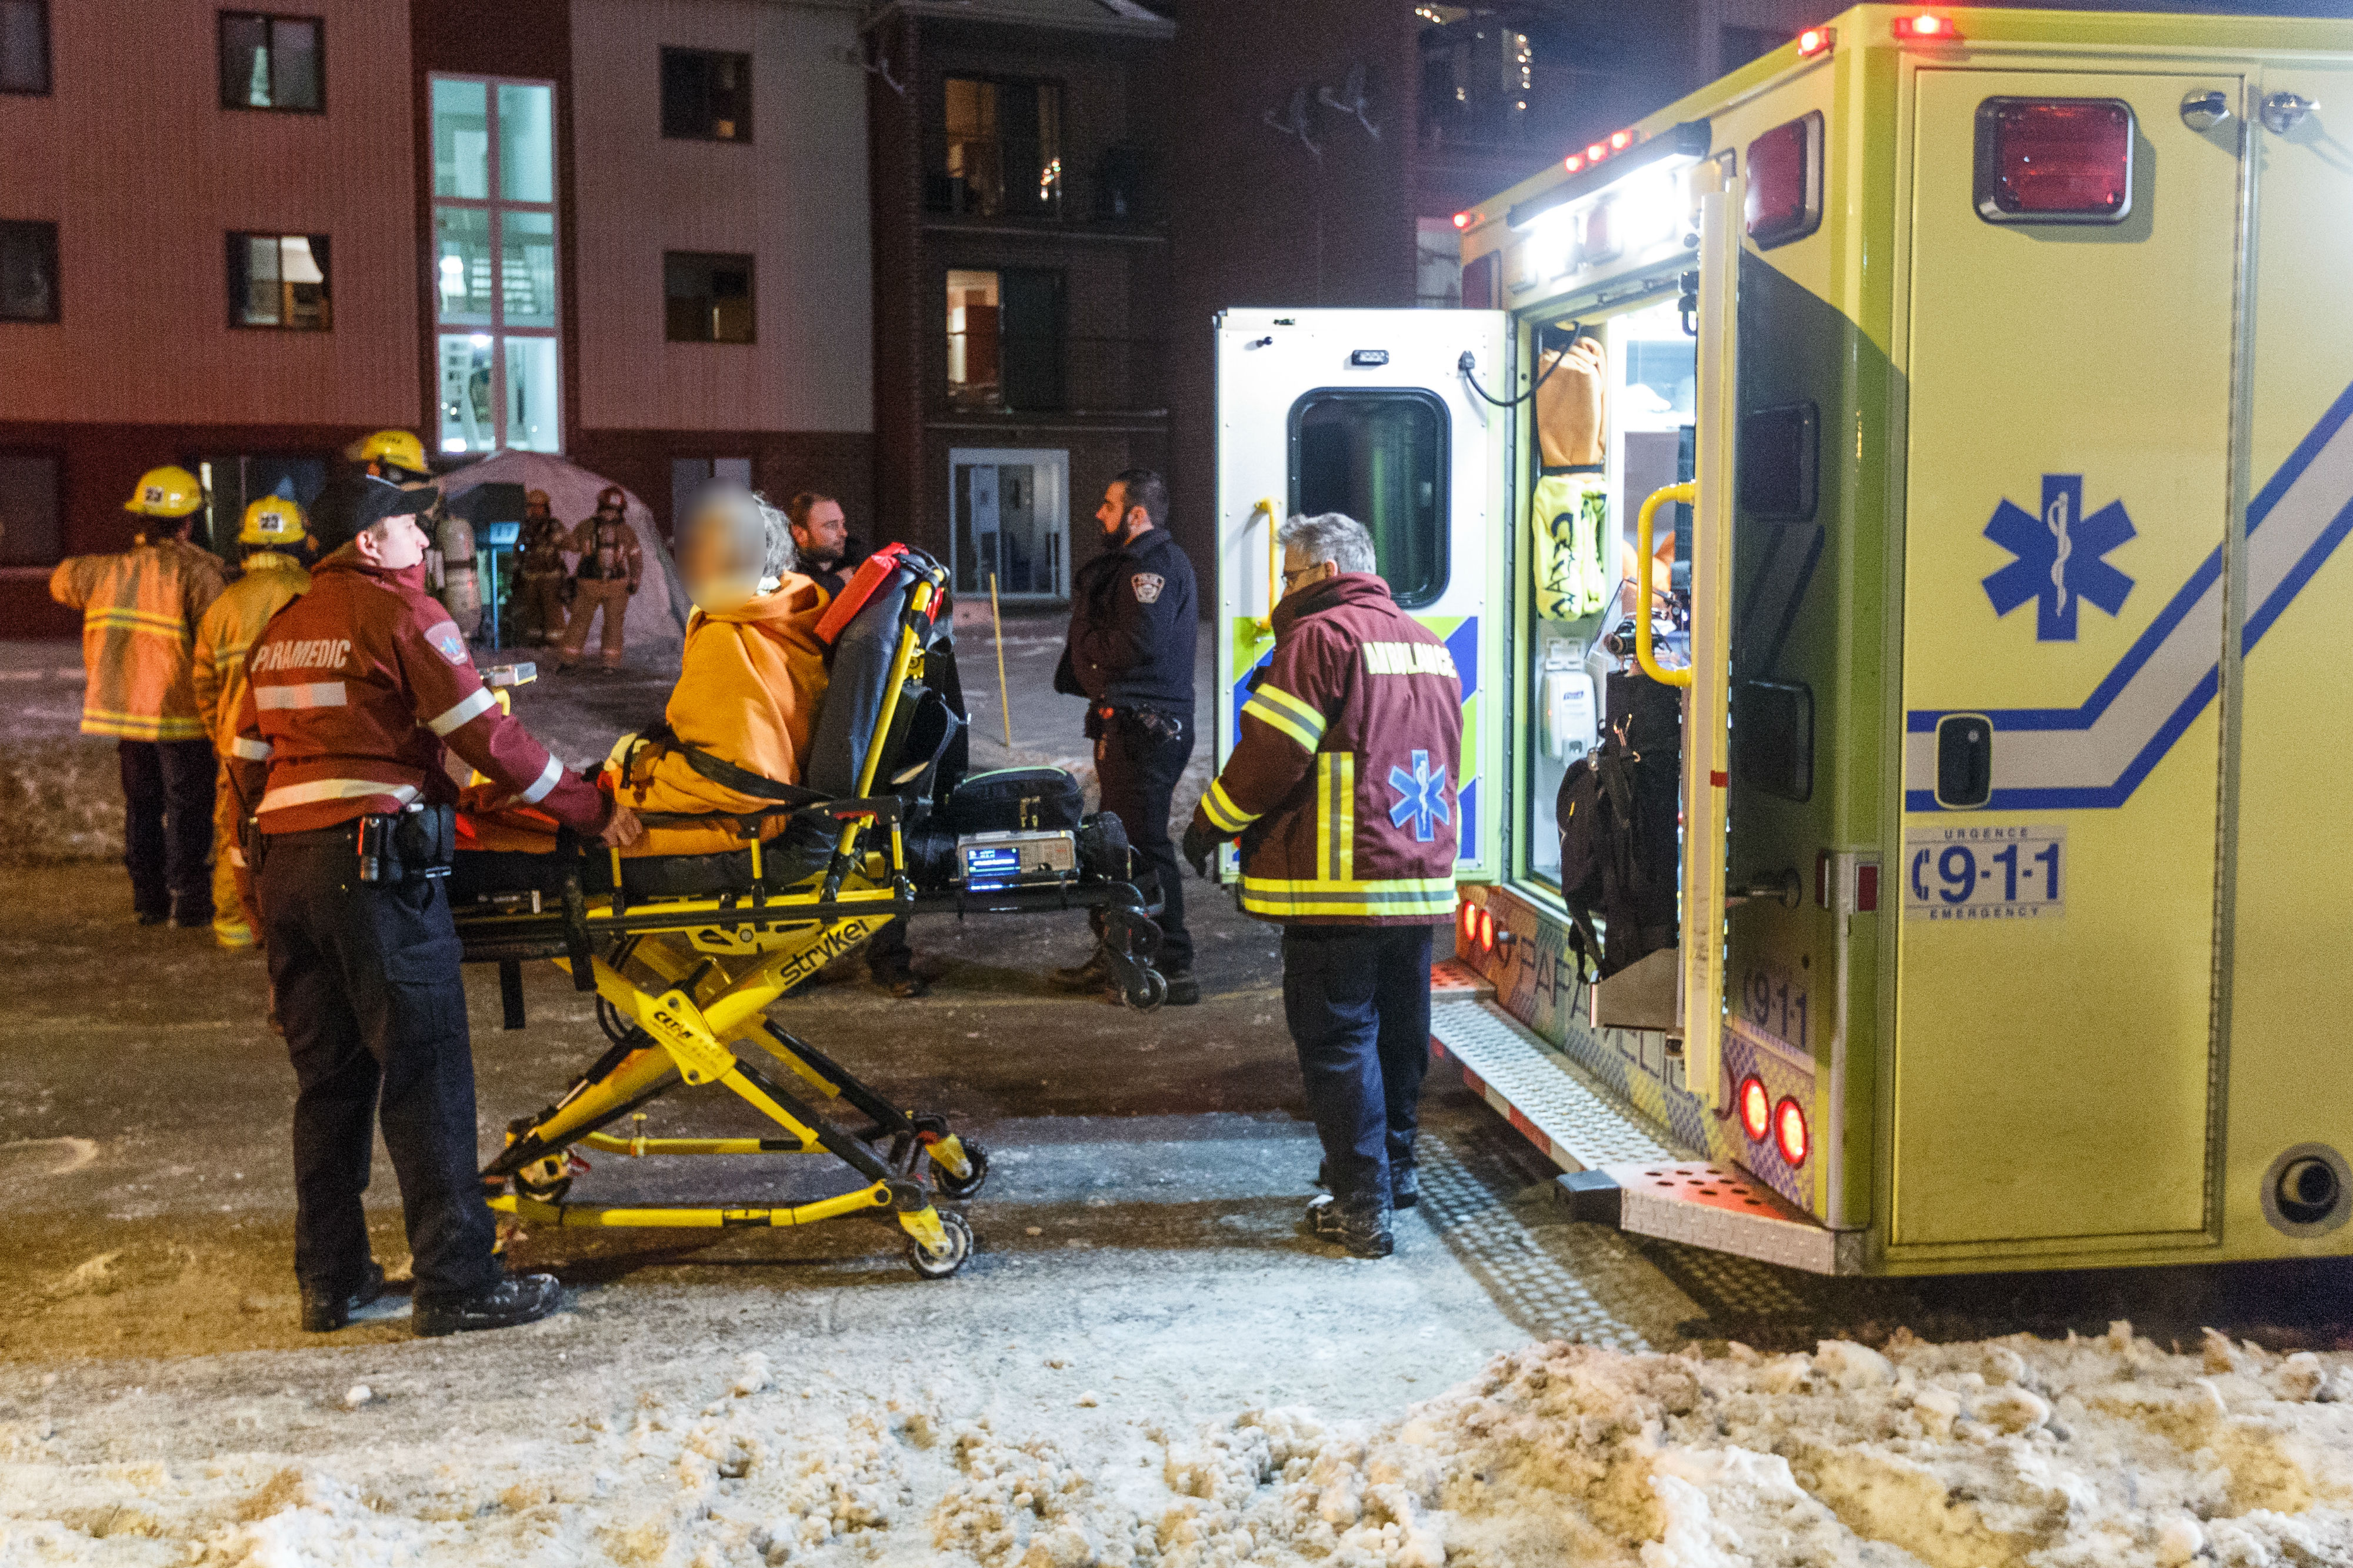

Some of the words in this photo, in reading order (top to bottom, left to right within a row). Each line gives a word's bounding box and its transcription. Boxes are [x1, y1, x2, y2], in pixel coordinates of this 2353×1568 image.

[251, 639, 351, 672] PARAMEDIC
[1944, 828, 2028, 840] URGENCE
[1938, 843, 2059, 903] 9-1-1
[1930, 907, 2039, 920] EMERGENCY
